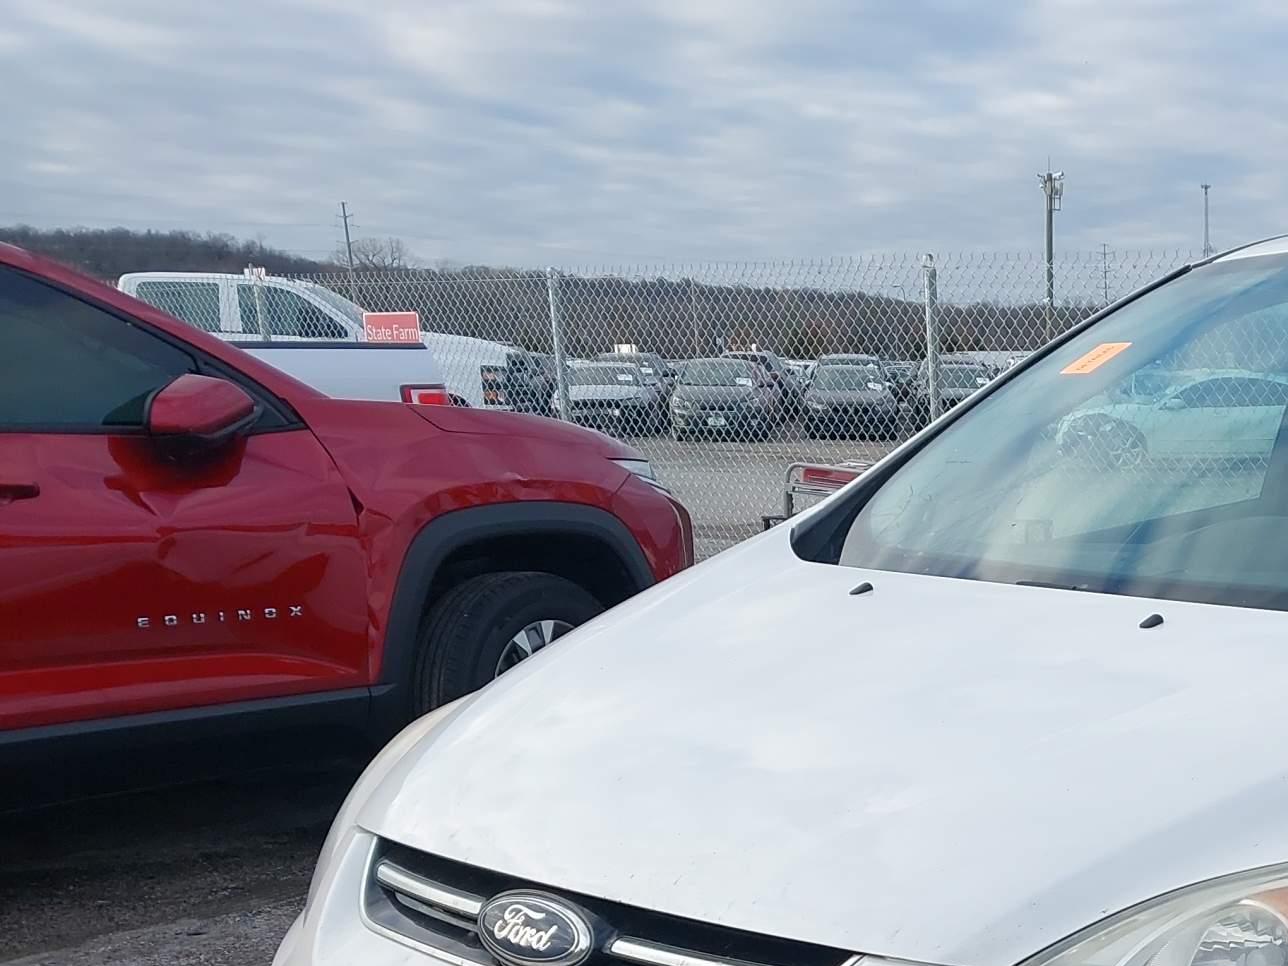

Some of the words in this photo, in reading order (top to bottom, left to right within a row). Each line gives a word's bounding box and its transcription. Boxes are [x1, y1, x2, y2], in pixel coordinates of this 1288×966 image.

[367, 325, 392, 341] State
[393, 324, 418, 340] Farm
[136, 605, 303, 628] EQUINOX
[493, 904, 559, 952] Ford
